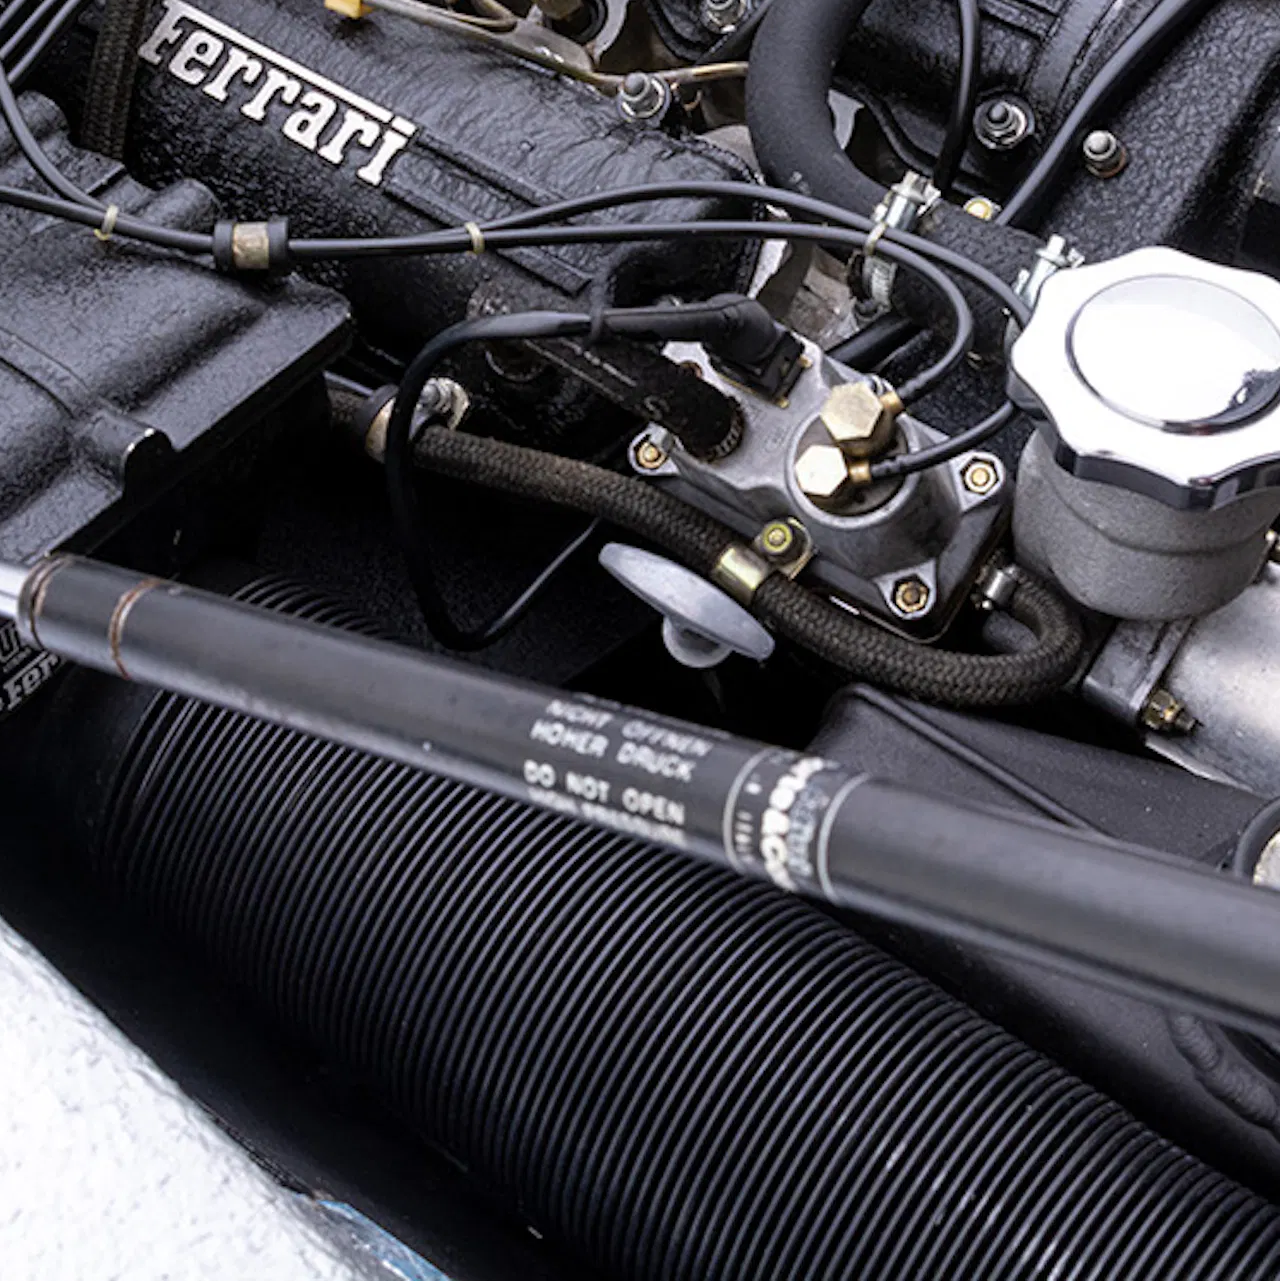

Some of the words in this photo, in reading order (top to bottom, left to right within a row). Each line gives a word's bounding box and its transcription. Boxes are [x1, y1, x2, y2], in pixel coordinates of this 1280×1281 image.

[524, 759, 556, 789] DO
[566, 771, 610, 803] NOT
[622, 787, 686, 826] OPEN
